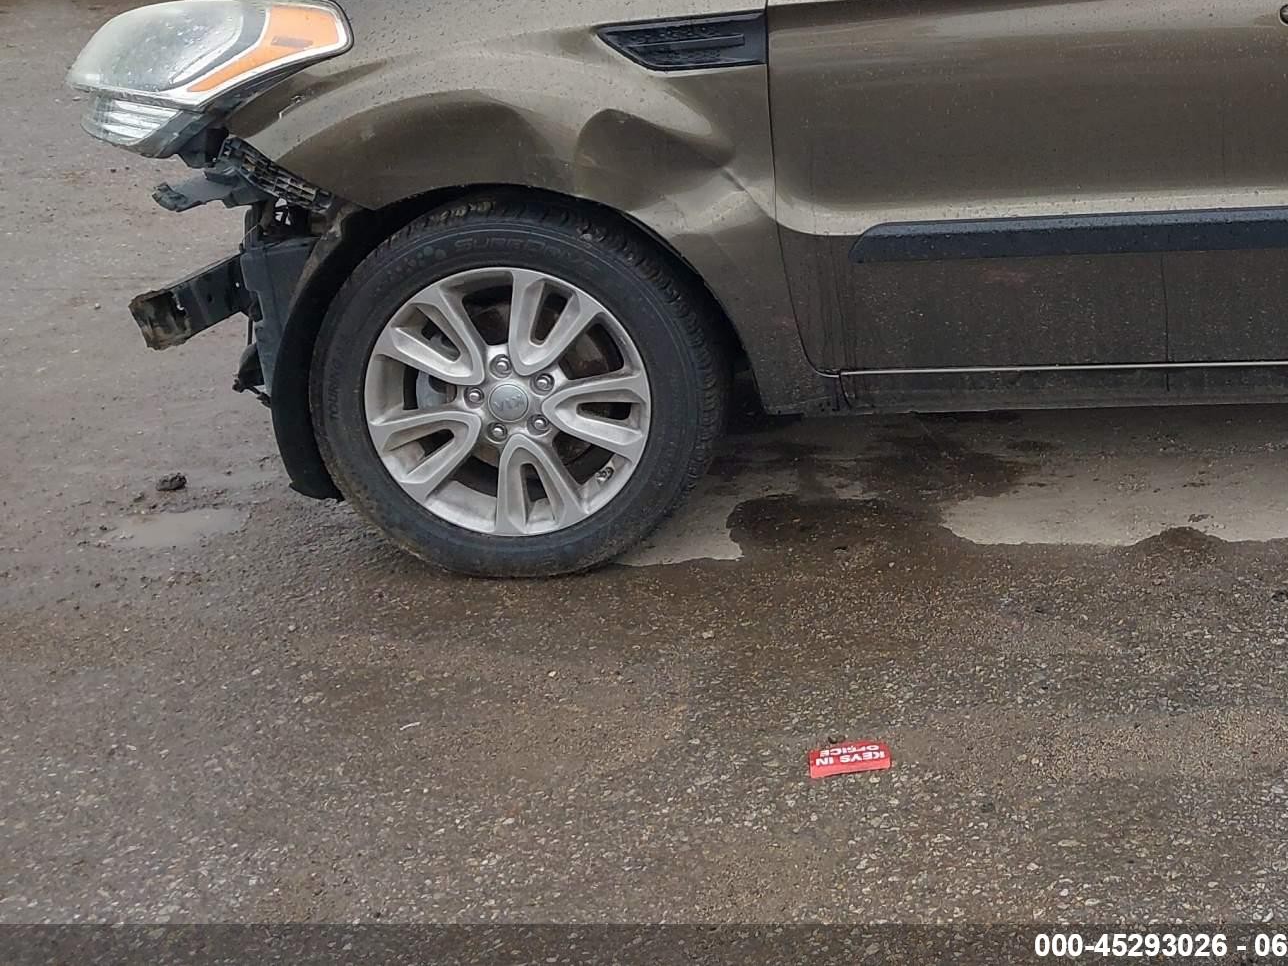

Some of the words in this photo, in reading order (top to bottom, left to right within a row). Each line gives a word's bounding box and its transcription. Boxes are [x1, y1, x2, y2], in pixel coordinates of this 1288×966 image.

[820, 745, 880, 757] OFFICE
[840, 751, 885, 763] KEYS
[815, 756, 834, 766] IN
